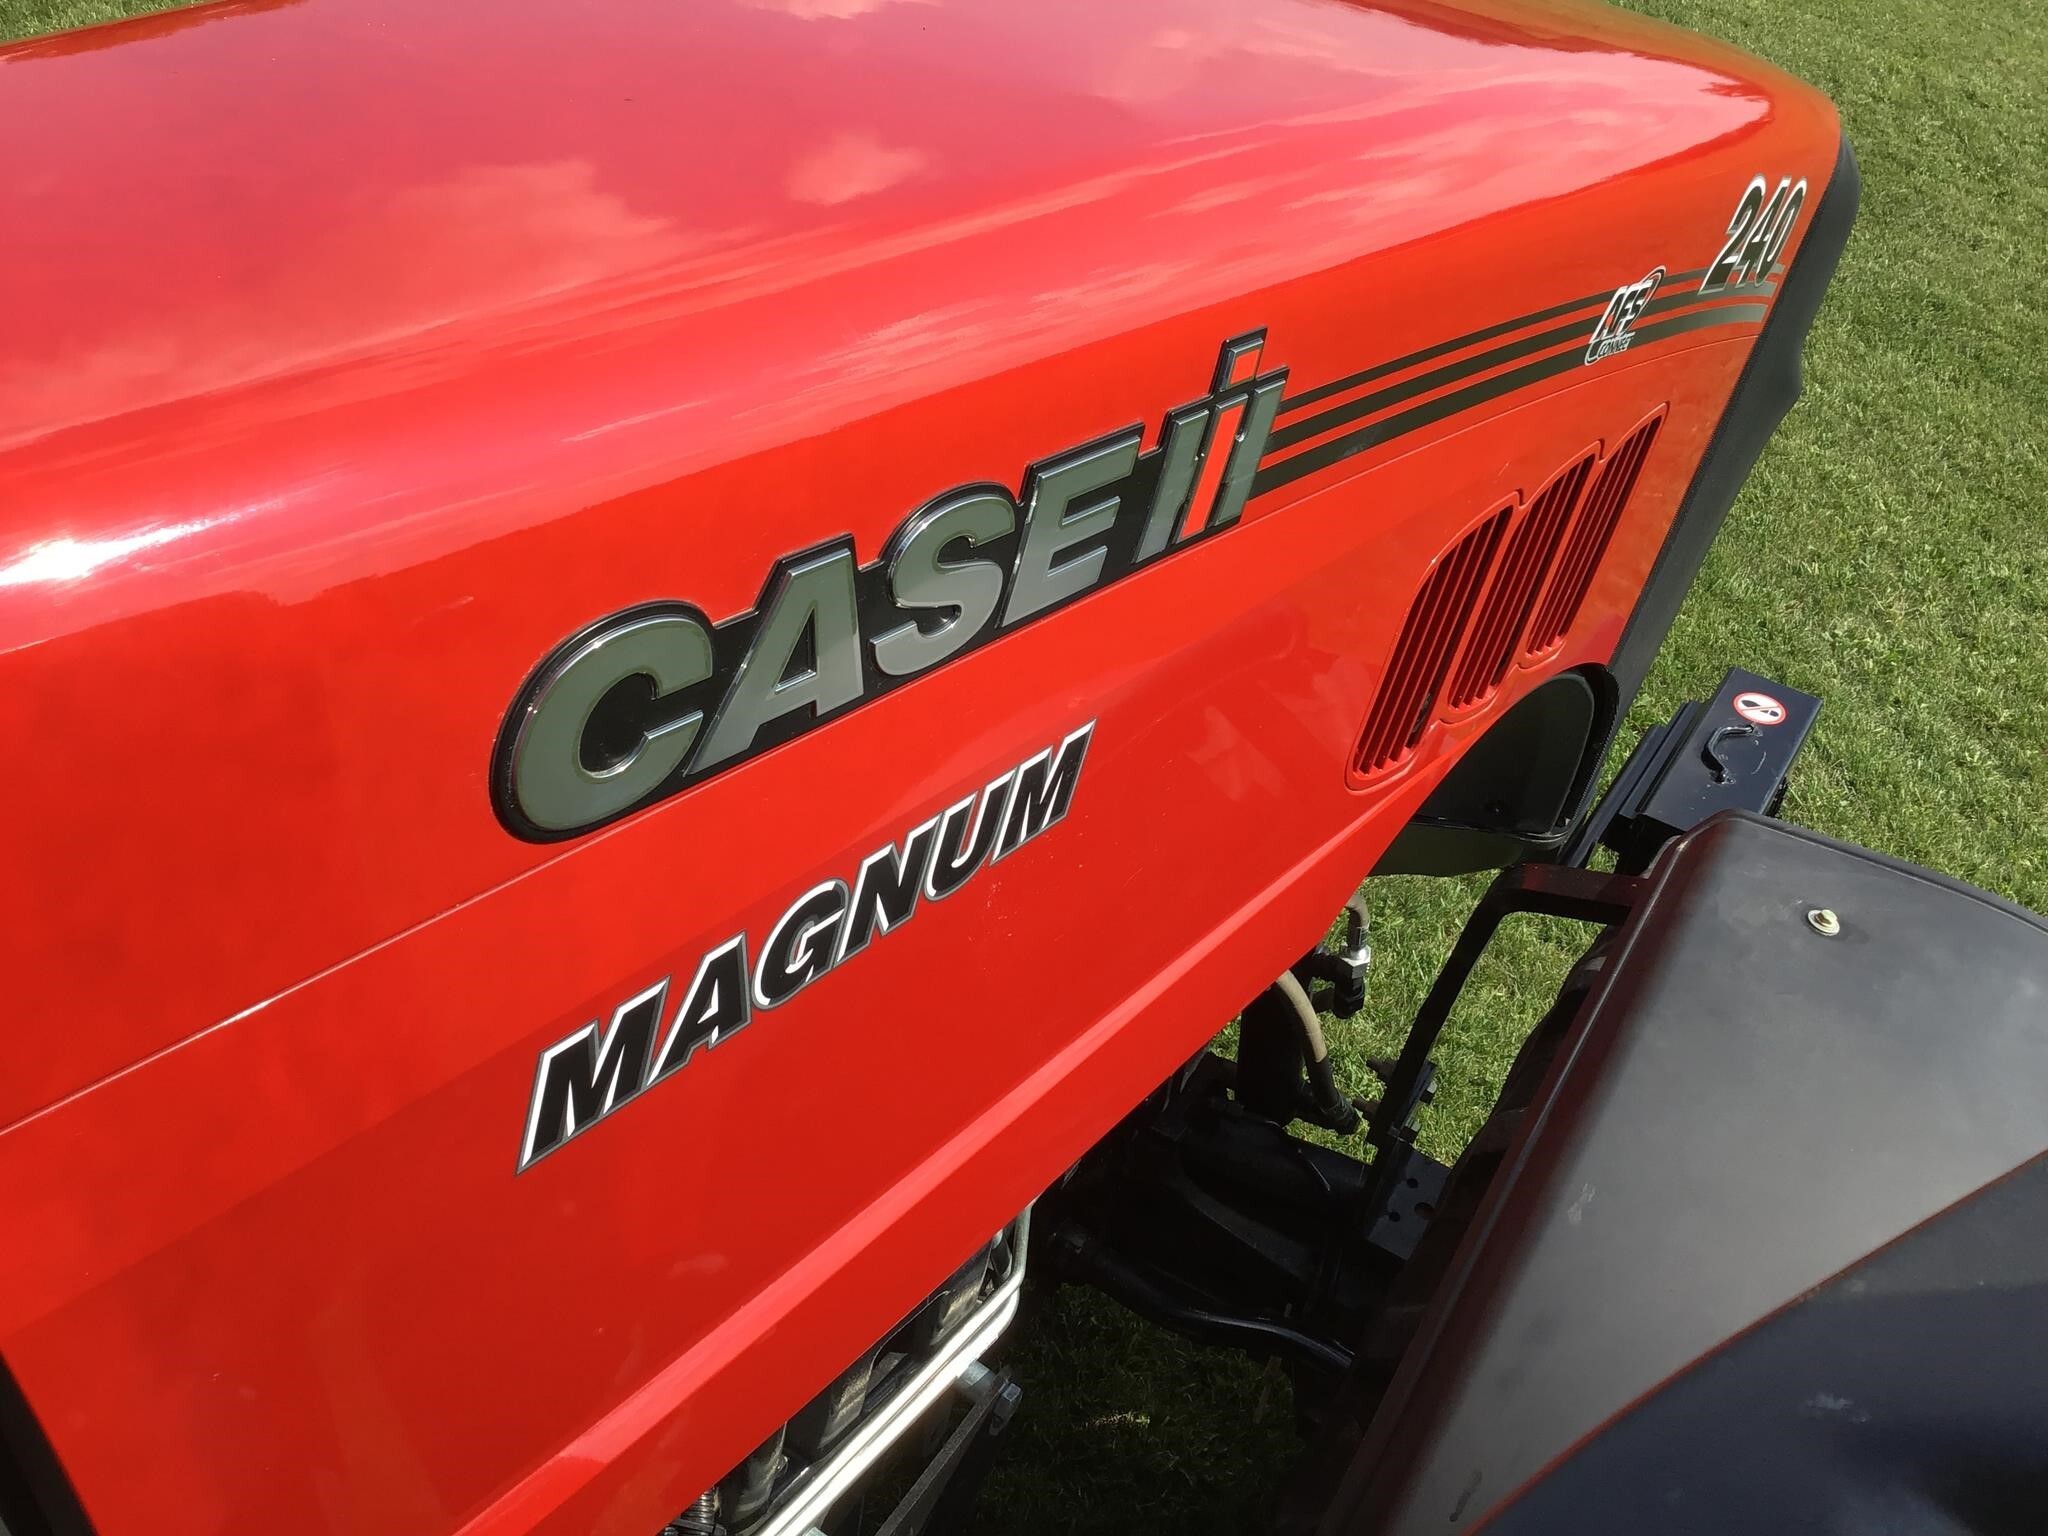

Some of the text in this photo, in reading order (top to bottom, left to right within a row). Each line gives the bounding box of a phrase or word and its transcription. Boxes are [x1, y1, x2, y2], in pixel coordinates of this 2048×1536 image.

[1591, 278, 1654, 340] AFS
[1698, 174, 1807, 295] 240
[511, 432, 1141, 830] CASE
[517, 719, 1096, 1176] MAGNUM
